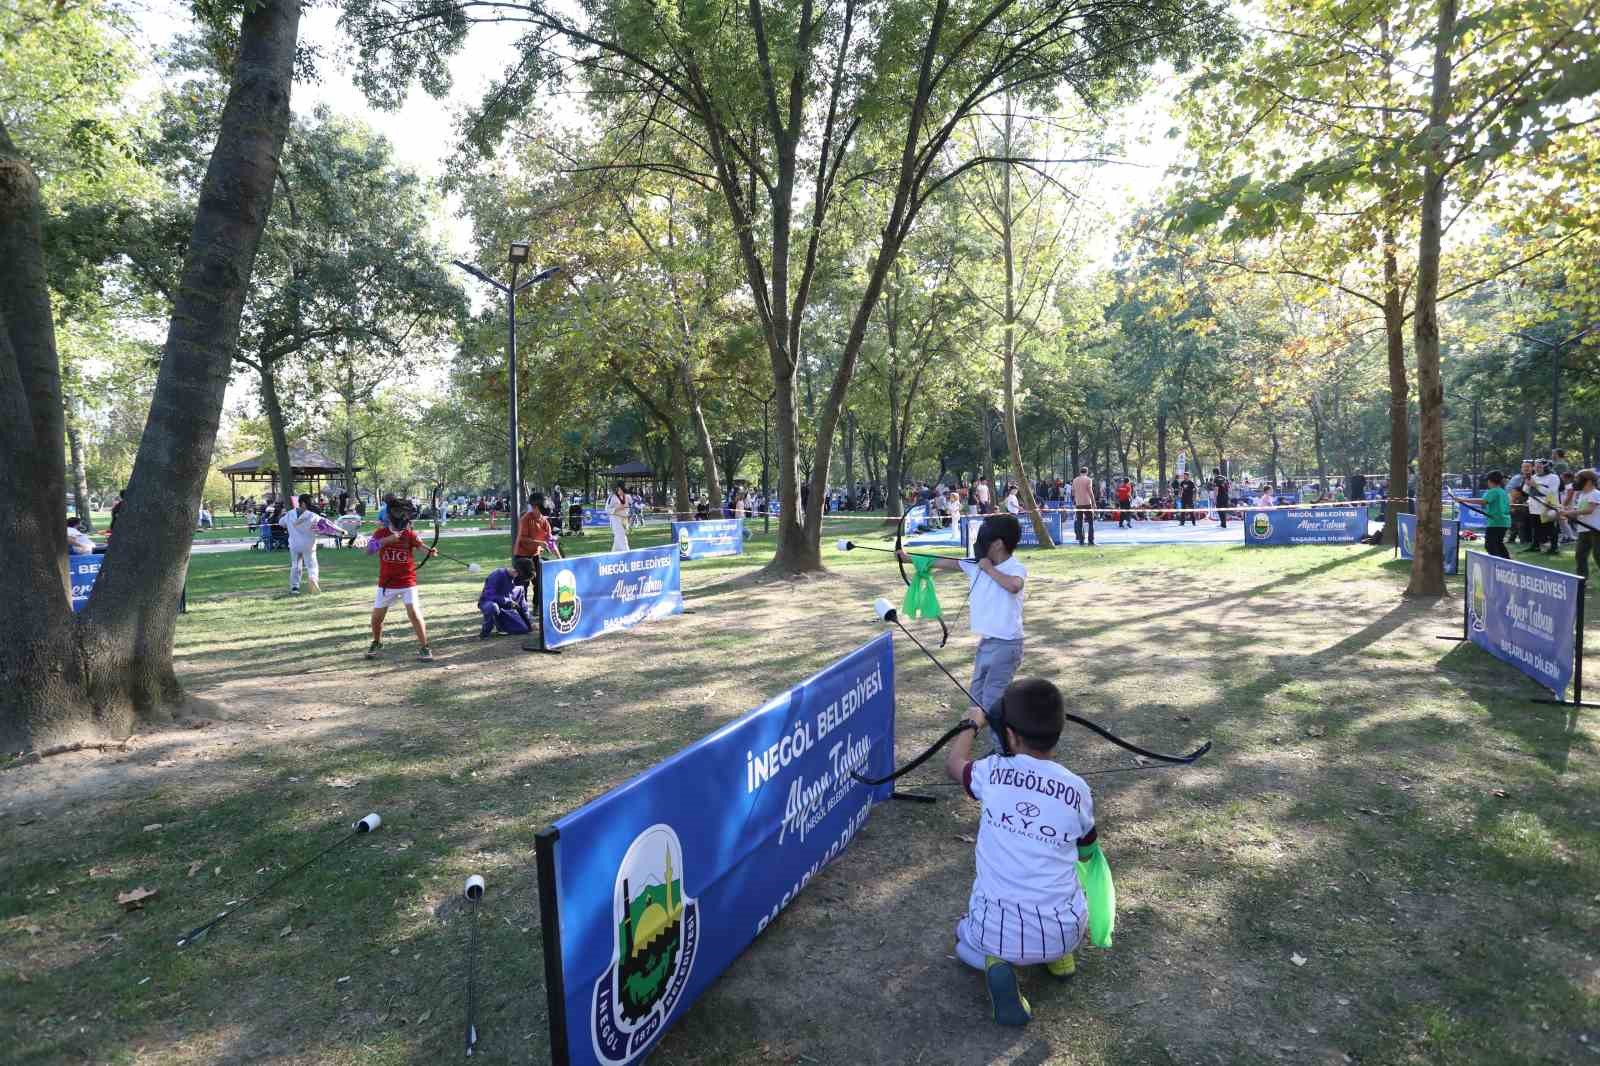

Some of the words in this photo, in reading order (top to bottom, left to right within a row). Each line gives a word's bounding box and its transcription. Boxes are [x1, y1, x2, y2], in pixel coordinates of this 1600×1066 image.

[599, 559, 629, 577] İNEGÖL
[1520, 575, 1567, 600] BELEDİYESİ
[747, 720, 814, 794] İNEGÖL
[817, 662, 883, 741] BELEDİYESİ
[634, 1017, 658, 1045] 1870
